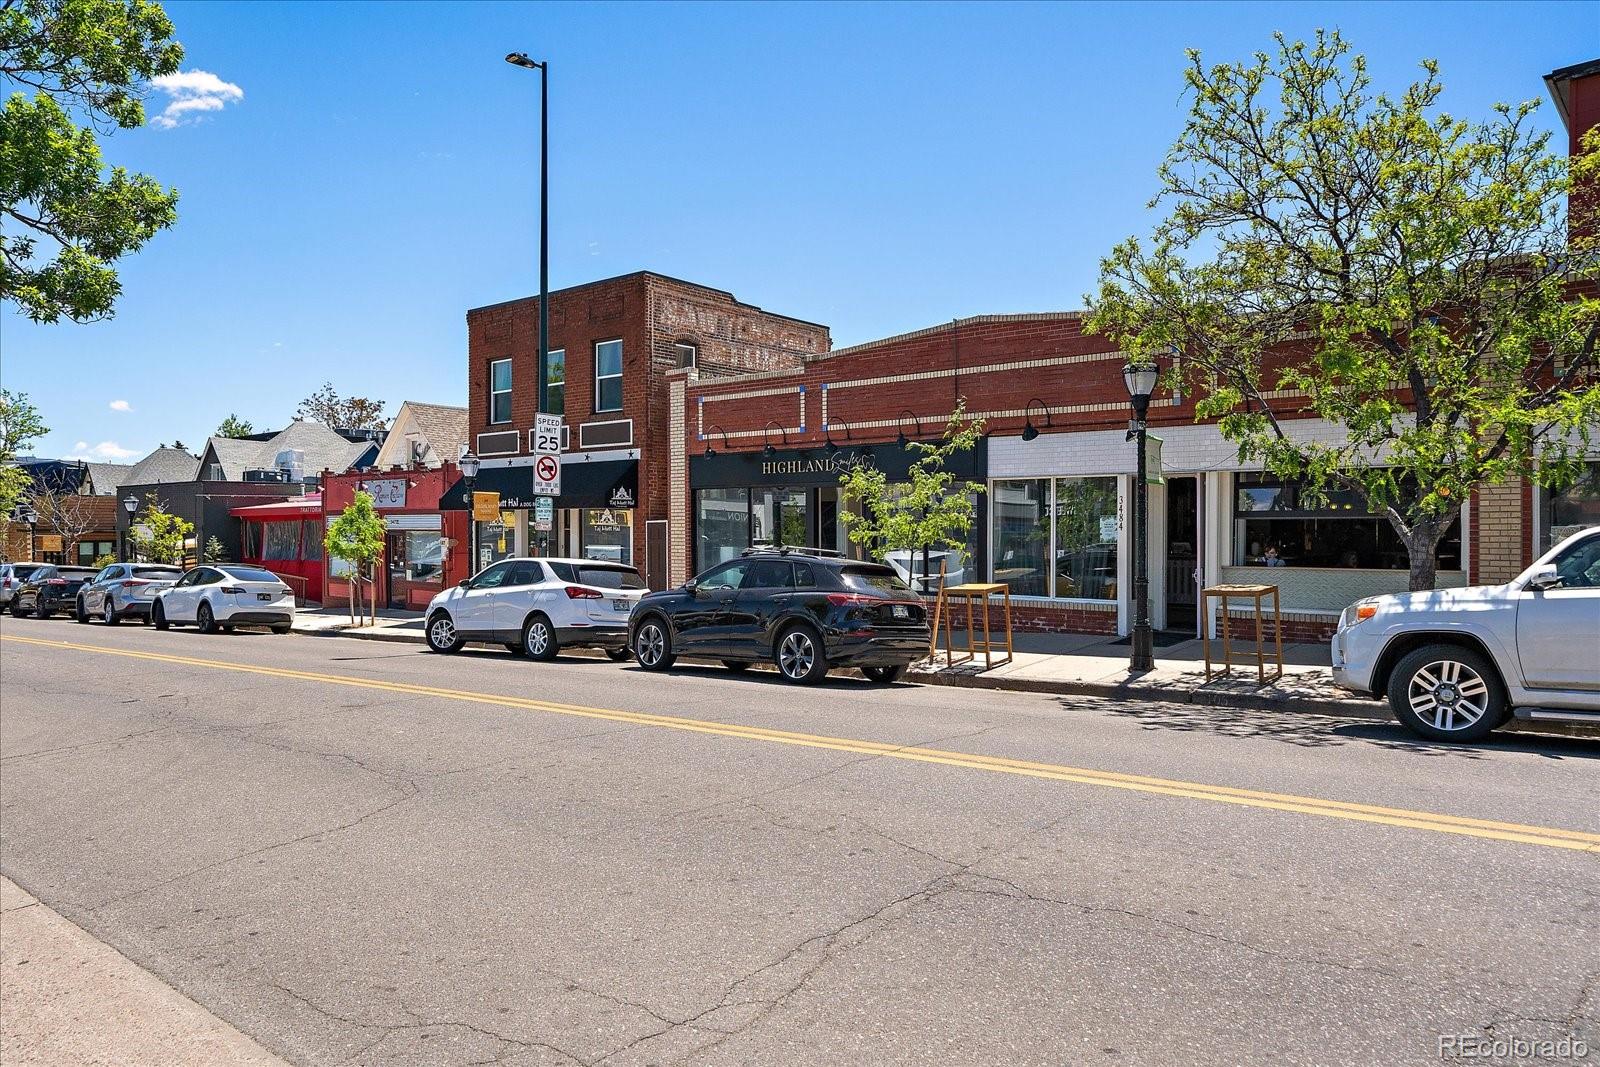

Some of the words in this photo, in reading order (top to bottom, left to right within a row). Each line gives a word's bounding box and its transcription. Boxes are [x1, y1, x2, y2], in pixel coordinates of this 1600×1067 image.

[537, 417, 560, 426] SPEED
[539, 426, 557, 434] LIMIT
[538, 435, 558, 451] 25
[762, 459, 834, 474] HIGHLAND
